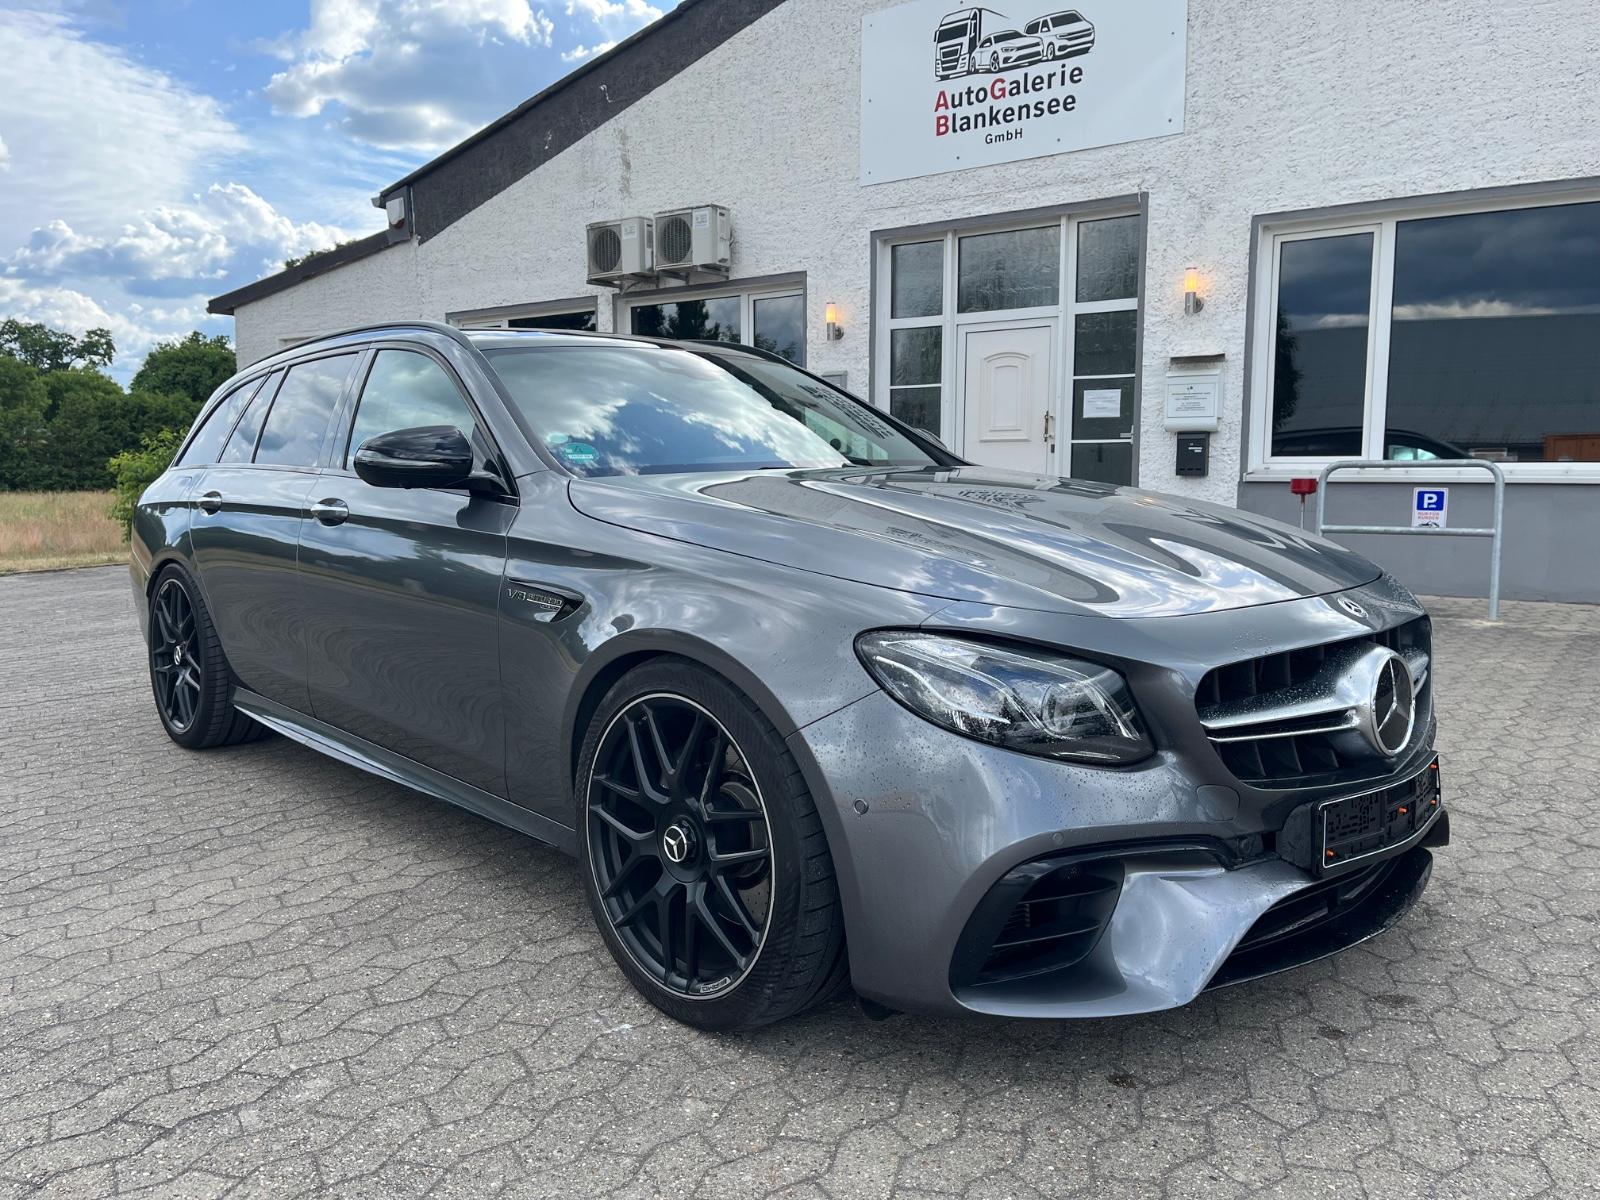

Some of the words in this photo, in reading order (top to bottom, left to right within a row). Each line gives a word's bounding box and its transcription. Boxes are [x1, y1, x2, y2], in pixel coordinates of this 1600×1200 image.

[934, 63, 1083, 112] AutoGalerie
[935, 94, 1077, 136] Blankensee
[985, 128, 1023, 144] GmbH
[1423, 493, 1438, 508] P
